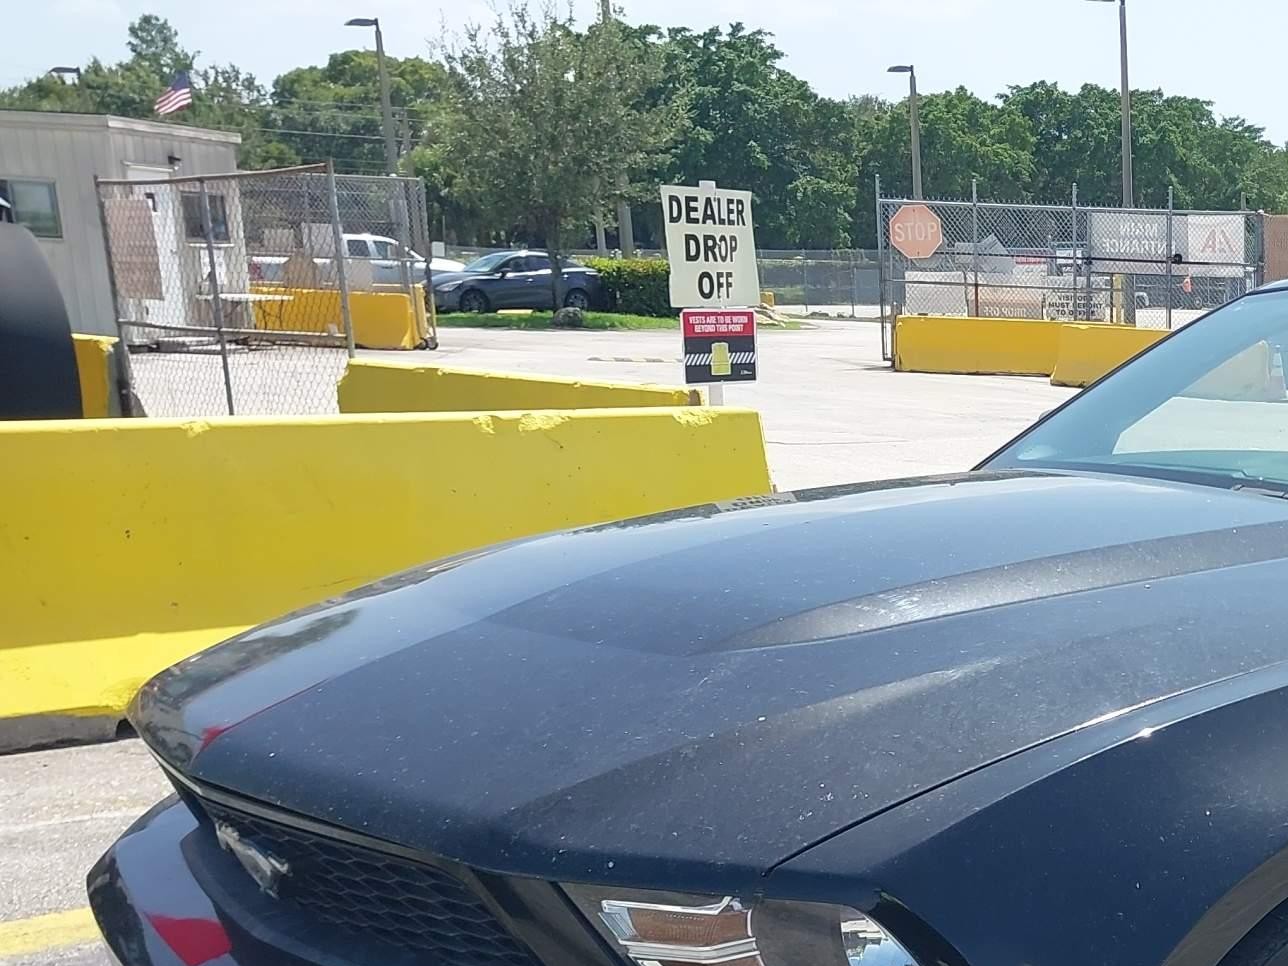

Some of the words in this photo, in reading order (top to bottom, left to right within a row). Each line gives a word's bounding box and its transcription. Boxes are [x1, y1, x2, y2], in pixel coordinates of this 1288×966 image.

[668, 195, 746, 226] DEALER
[894, 222, 938, 241] STOP
[684, 234, 738, 263] DROP
[698, 271, 733, 299] OFF
